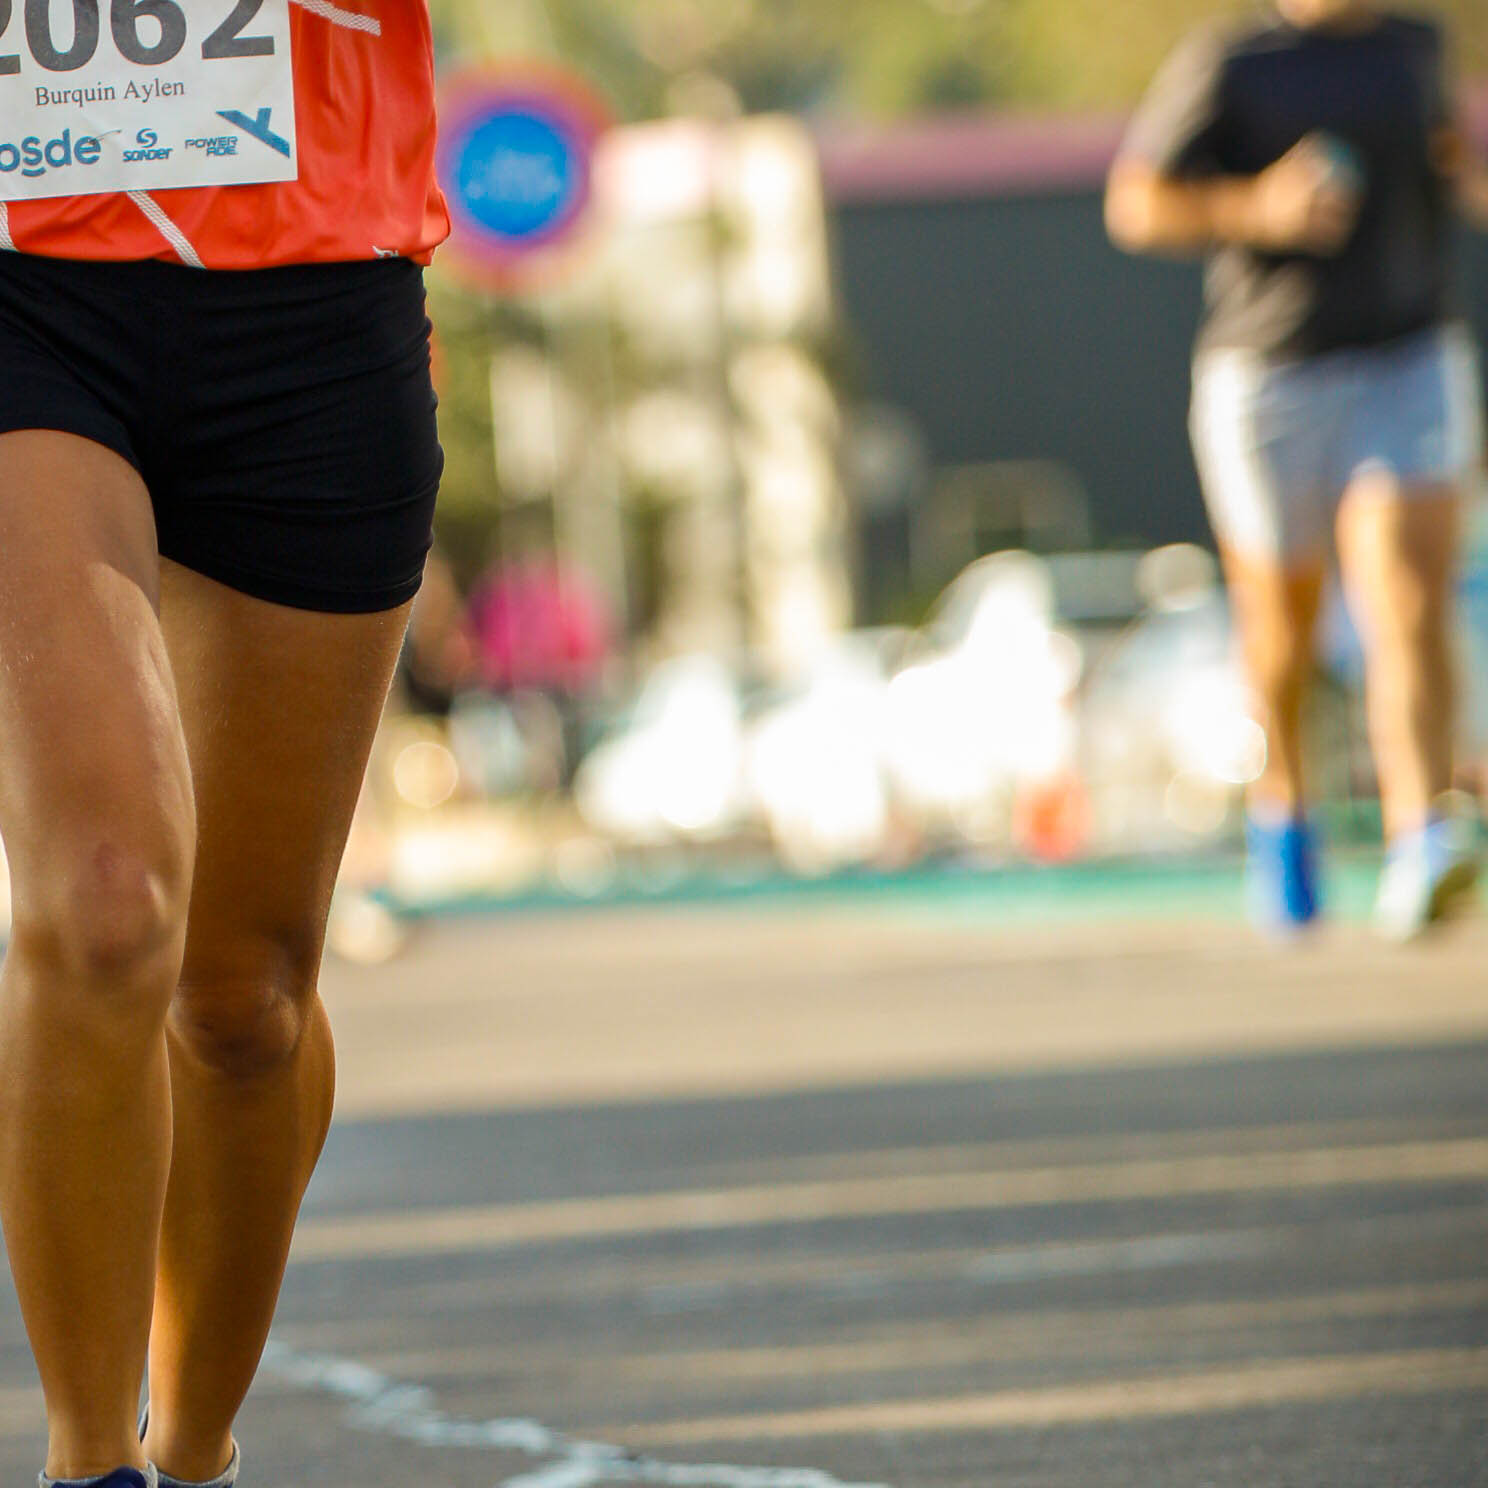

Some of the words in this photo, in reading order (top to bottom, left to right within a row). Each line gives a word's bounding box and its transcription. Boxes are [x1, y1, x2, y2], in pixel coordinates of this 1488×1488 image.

[35, 81, 116, 108] Burquin
[123, 77, 185, 103] Aylen
[184, 135, 239, 149] POWER
